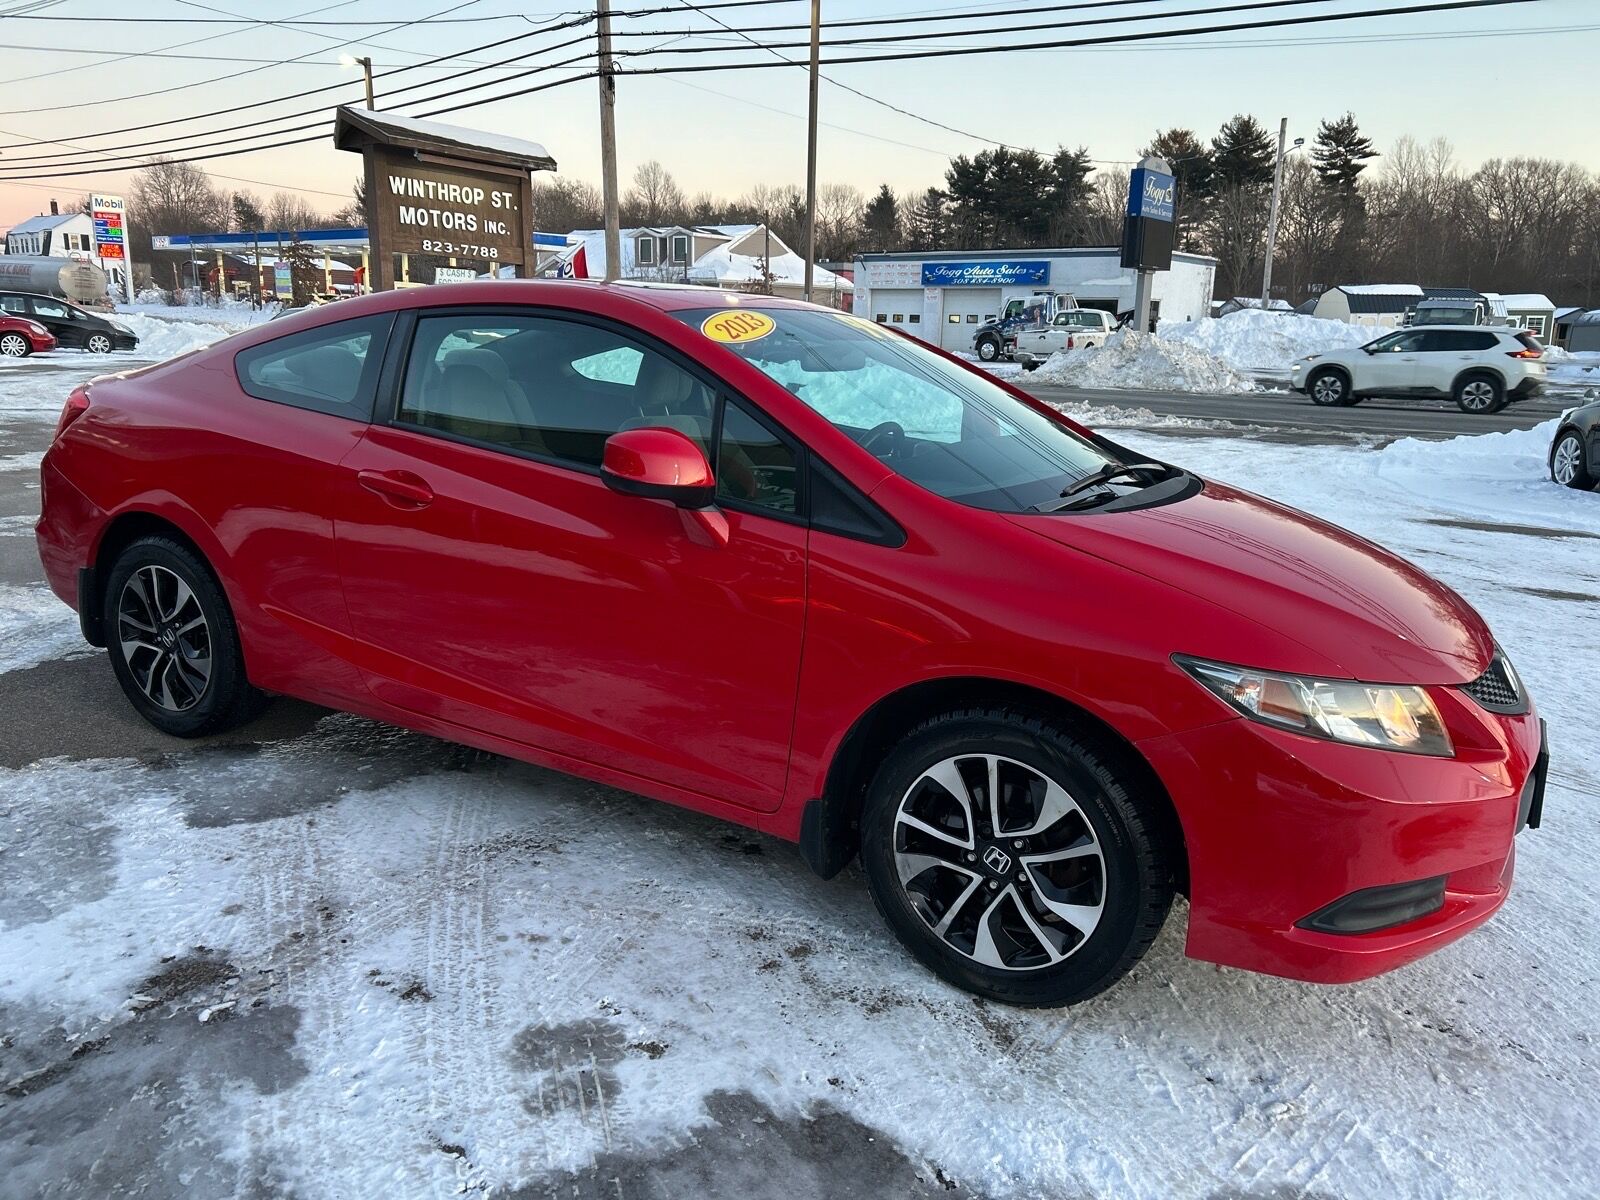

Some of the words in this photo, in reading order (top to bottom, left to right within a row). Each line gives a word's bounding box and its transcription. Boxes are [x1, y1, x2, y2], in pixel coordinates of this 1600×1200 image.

[94, 197, 123, 209] Mobil
[388, 175, 485, 206] WINTHROP
[491, 190, 518, 211] ST.
[399, 205, 478, 232] MOTORS
[484, 219, 511, 236] INC.
[422, 239, 499, 259] 823-7788
[446, 268, 466, 278] CASH
[963, 265, 995, 275] Auto
[996, 264, 1027, 275] Sales
[714, 312, 766, 340] 2013
